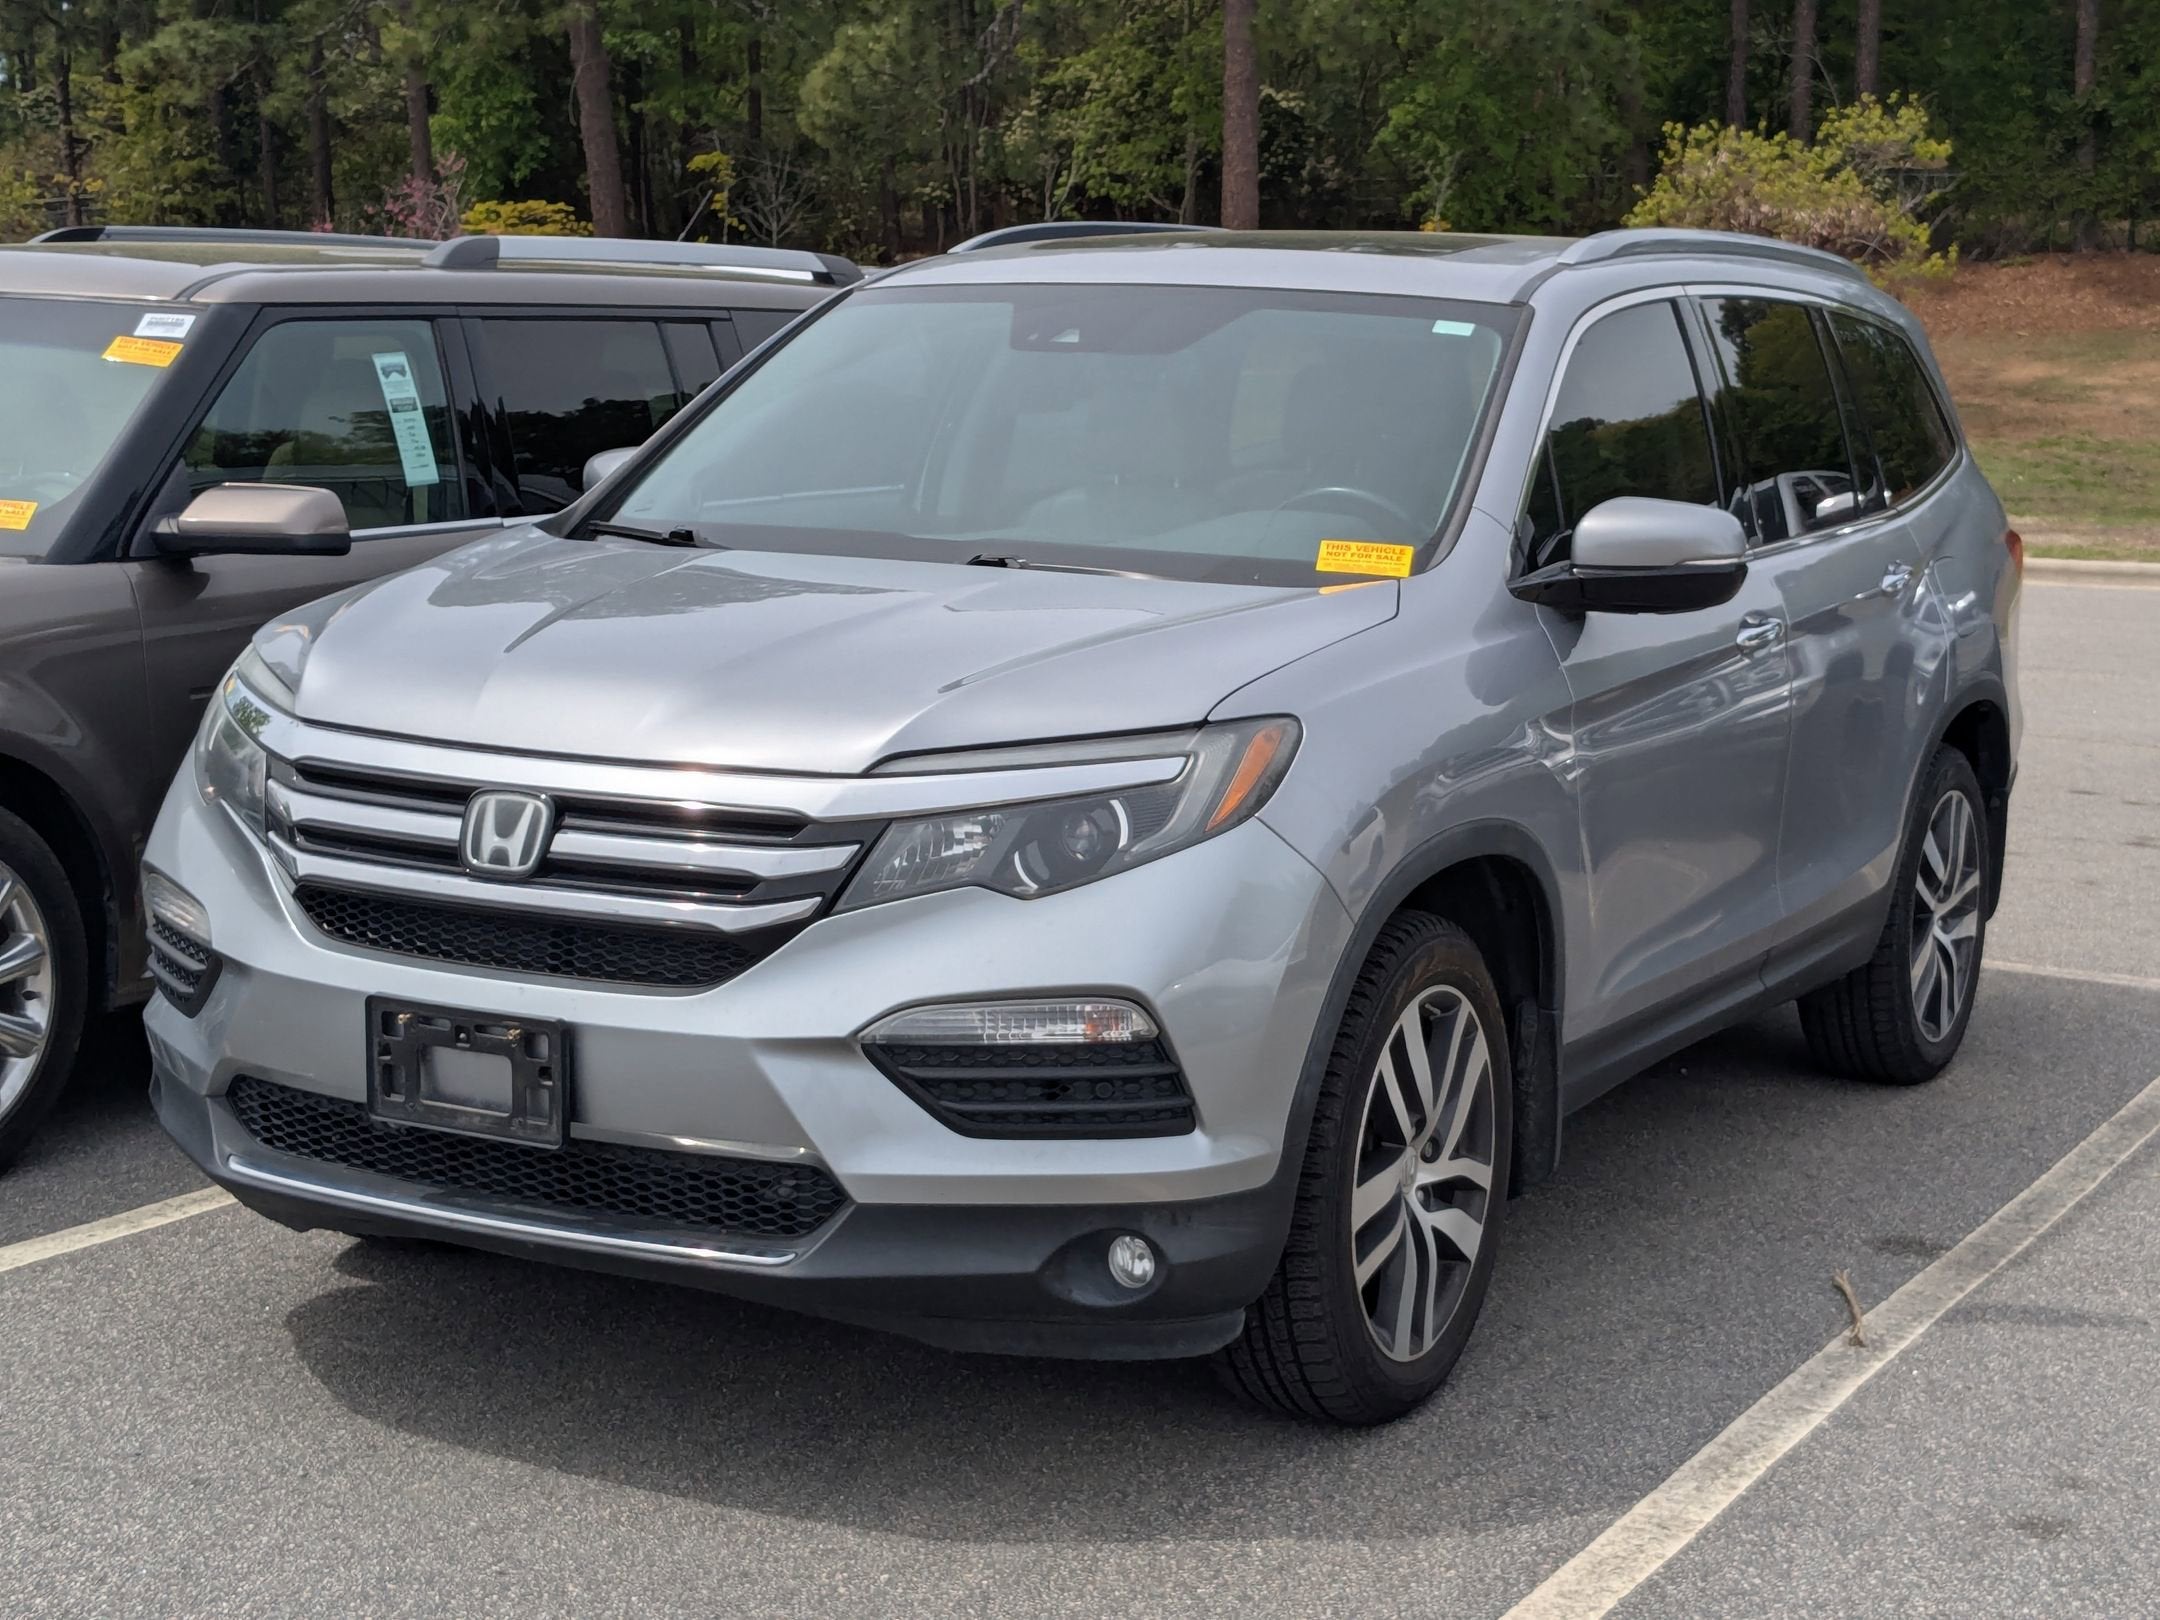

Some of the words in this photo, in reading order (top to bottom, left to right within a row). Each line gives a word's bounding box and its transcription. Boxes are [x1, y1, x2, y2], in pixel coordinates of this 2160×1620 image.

[1326, 543, 1351, 552] THIS
[1355, 545, 1406, 556] VEHICLE
[1375, 554, 1403, 562] SALE
